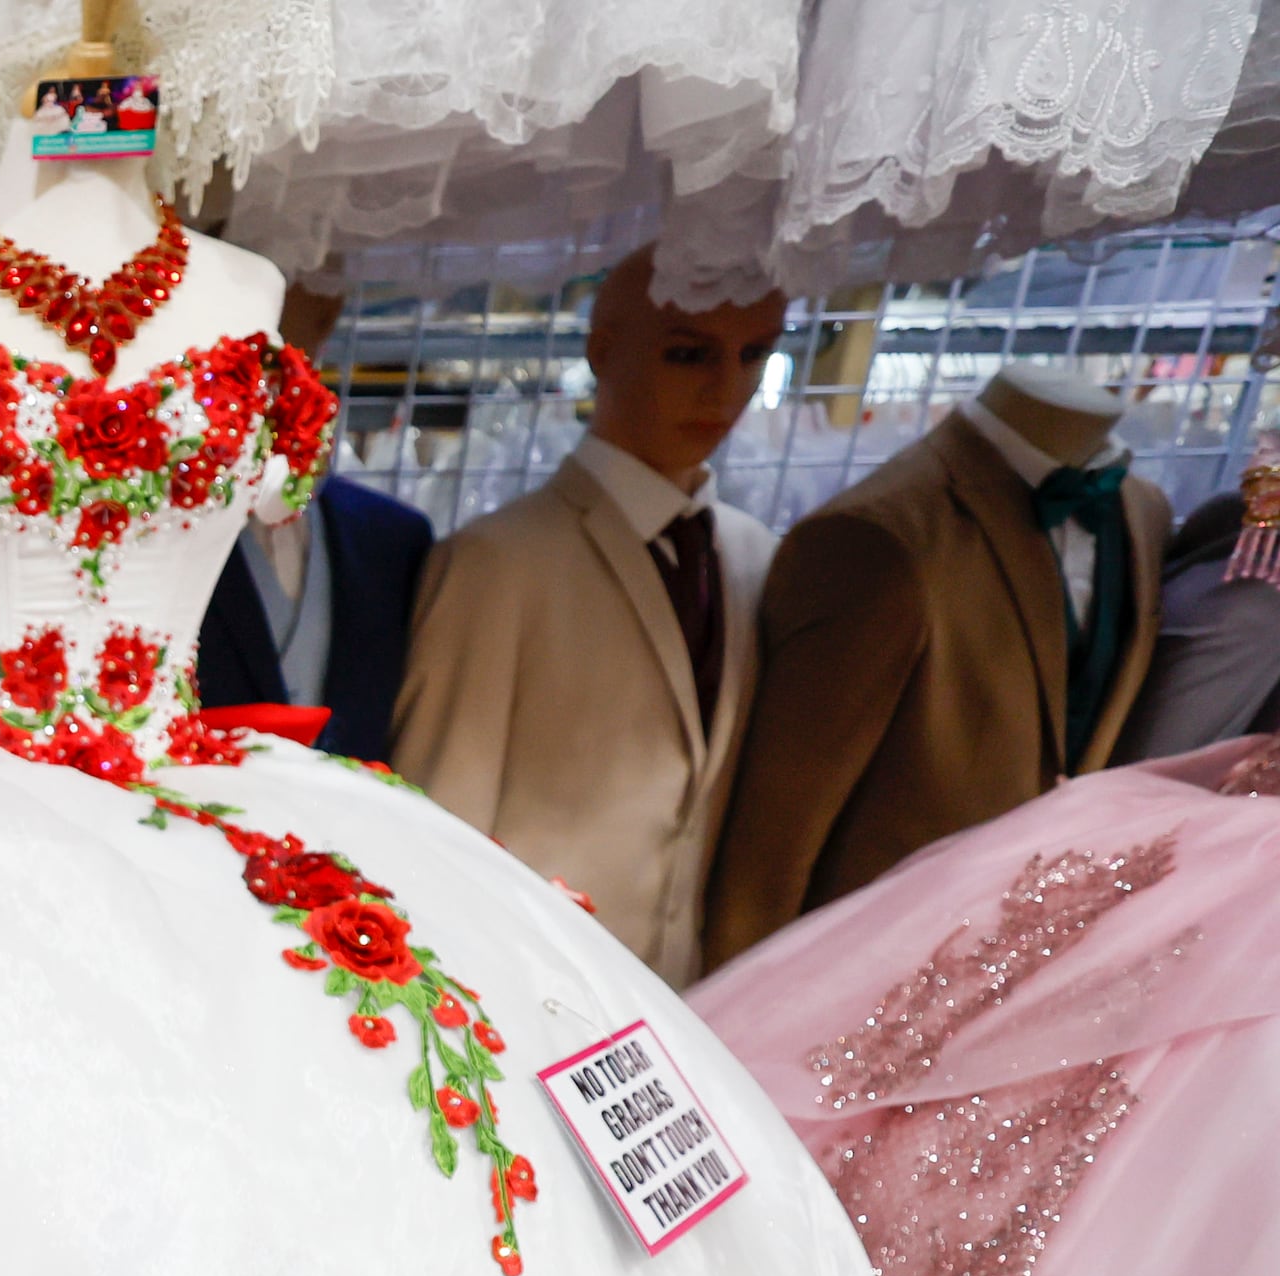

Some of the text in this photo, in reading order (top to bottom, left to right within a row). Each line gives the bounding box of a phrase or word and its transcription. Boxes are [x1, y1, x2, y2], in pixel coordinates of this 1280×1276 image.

[570, 1040, 653, 1103] NO TOCAR
[601, 1078, 675, 1141] GRACIAS
[610, 1108, 712, 1193] DON'T TOUCH
[643, 1149, 729, 1228] THANK YOU
